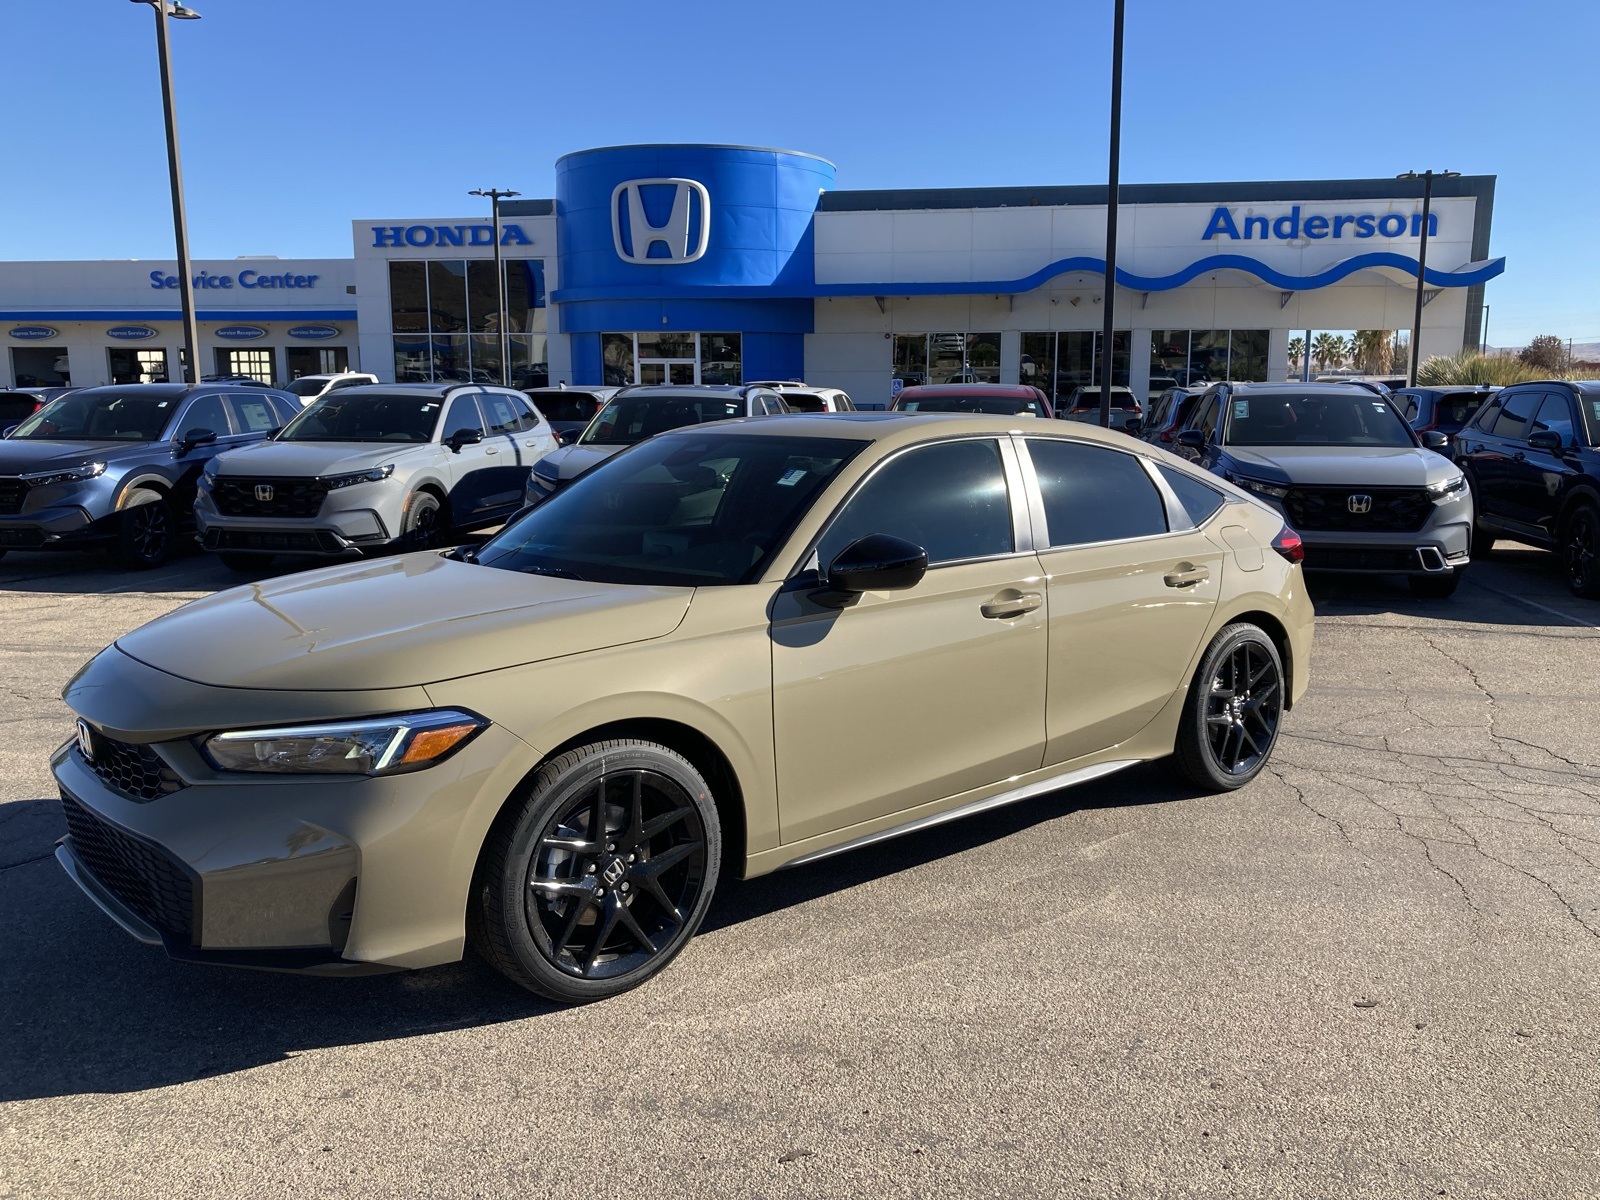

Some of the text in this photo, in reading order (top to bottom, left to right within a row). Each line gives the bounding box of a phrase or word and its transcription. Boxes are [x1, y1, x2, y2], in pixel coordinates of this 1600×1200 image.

[1201, 205, 1438, 240] Anderson
[371, 224, 533, 248] HONDA
[150, 270, 319, 289] Sevice Center
[660, 343, 708, 351] WELCOE
